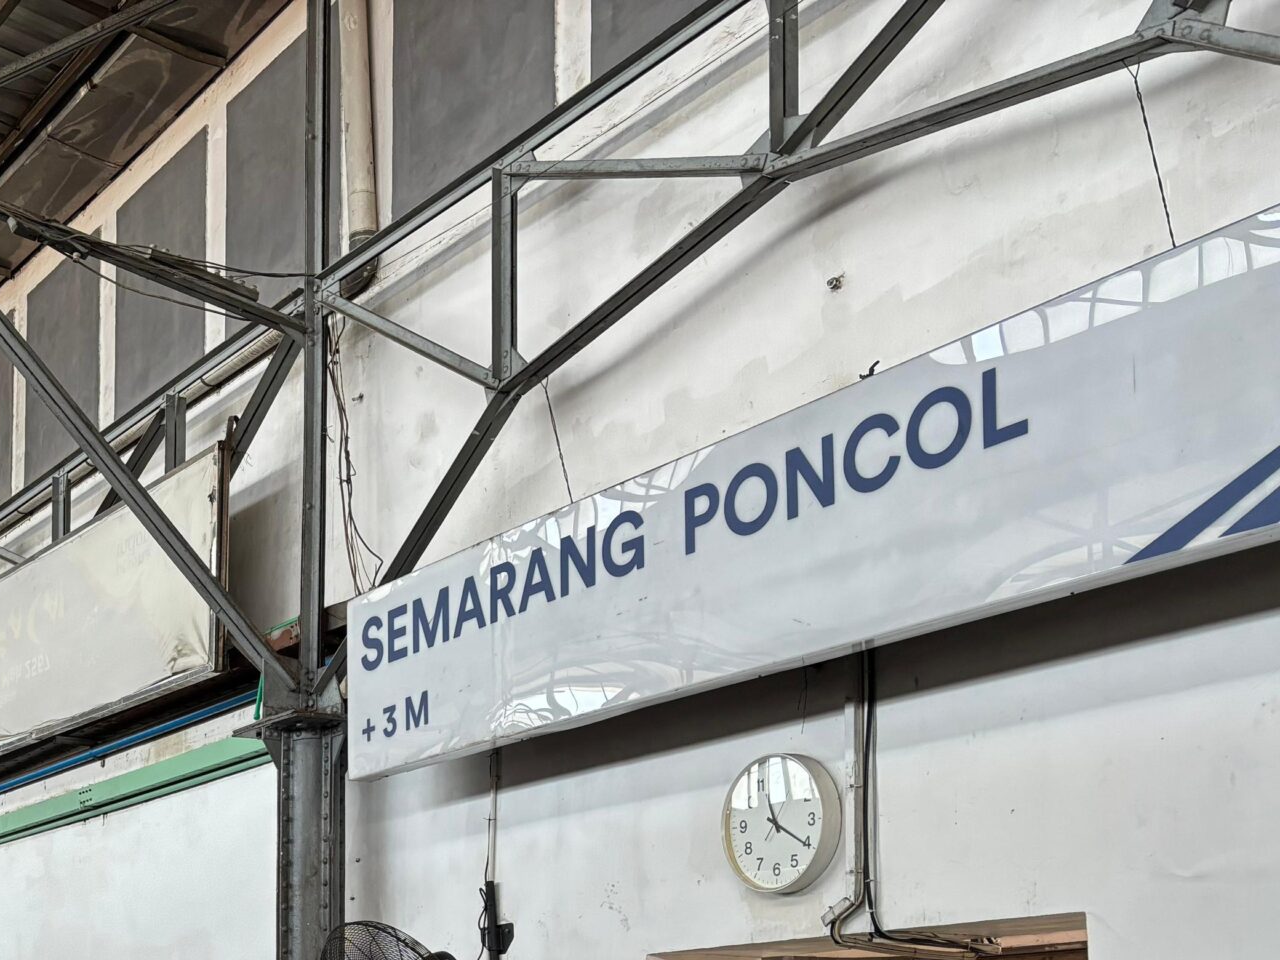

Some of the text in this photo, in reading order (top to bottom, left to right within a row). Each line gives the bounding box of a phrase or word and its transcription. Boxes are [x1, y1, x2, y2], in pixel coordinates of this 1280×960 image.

[361, 367, 1028, 671] SEMARANG PONCOL
[807, 812, 816, 827] 3
[739, 820, 748, 834] 9
[744, 841, 753, 855] 8
[756, 857, 764, 871] 7
[790, 854, 799, 868] 5
[773, 862, 781, 876] 6
